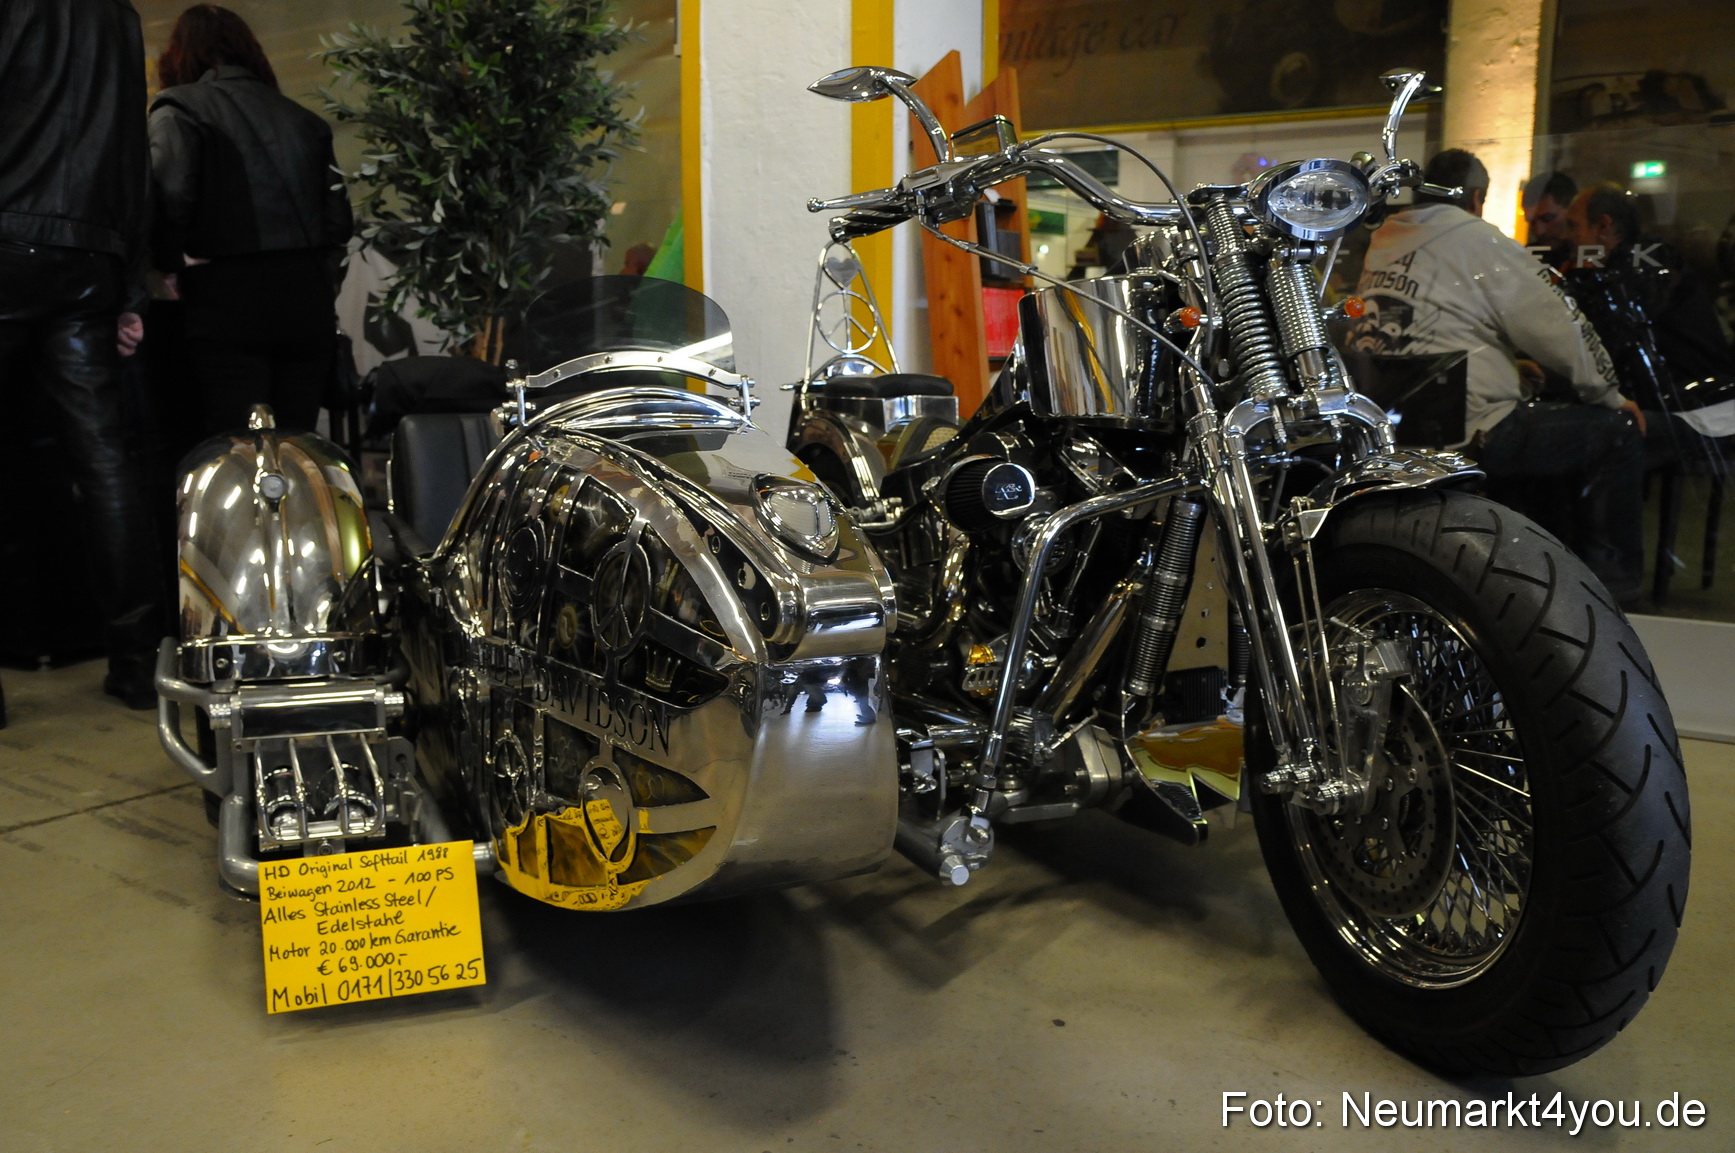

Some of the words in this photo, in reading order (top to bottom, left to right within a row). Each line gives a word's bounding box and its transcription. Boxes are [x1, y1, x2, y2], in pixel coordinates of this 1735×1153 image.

[535, 666, 671, 756] DAVIDSON
[265, 866, 290, 880] HD
[298, 858, 353, 878] Original
[416, 846, 449, 862] 1988
[267, 883, 332, 902] Beiwagen
[337, 877, 376, 894] 2012
[263, 907, 307, 925] Alles
[313, 898, 381, 917] Stainless
[269, 942, 312, 962] Motor
[395, 921, 462, 946] Garantie
[271, 983, 328, 1012] Mobil
